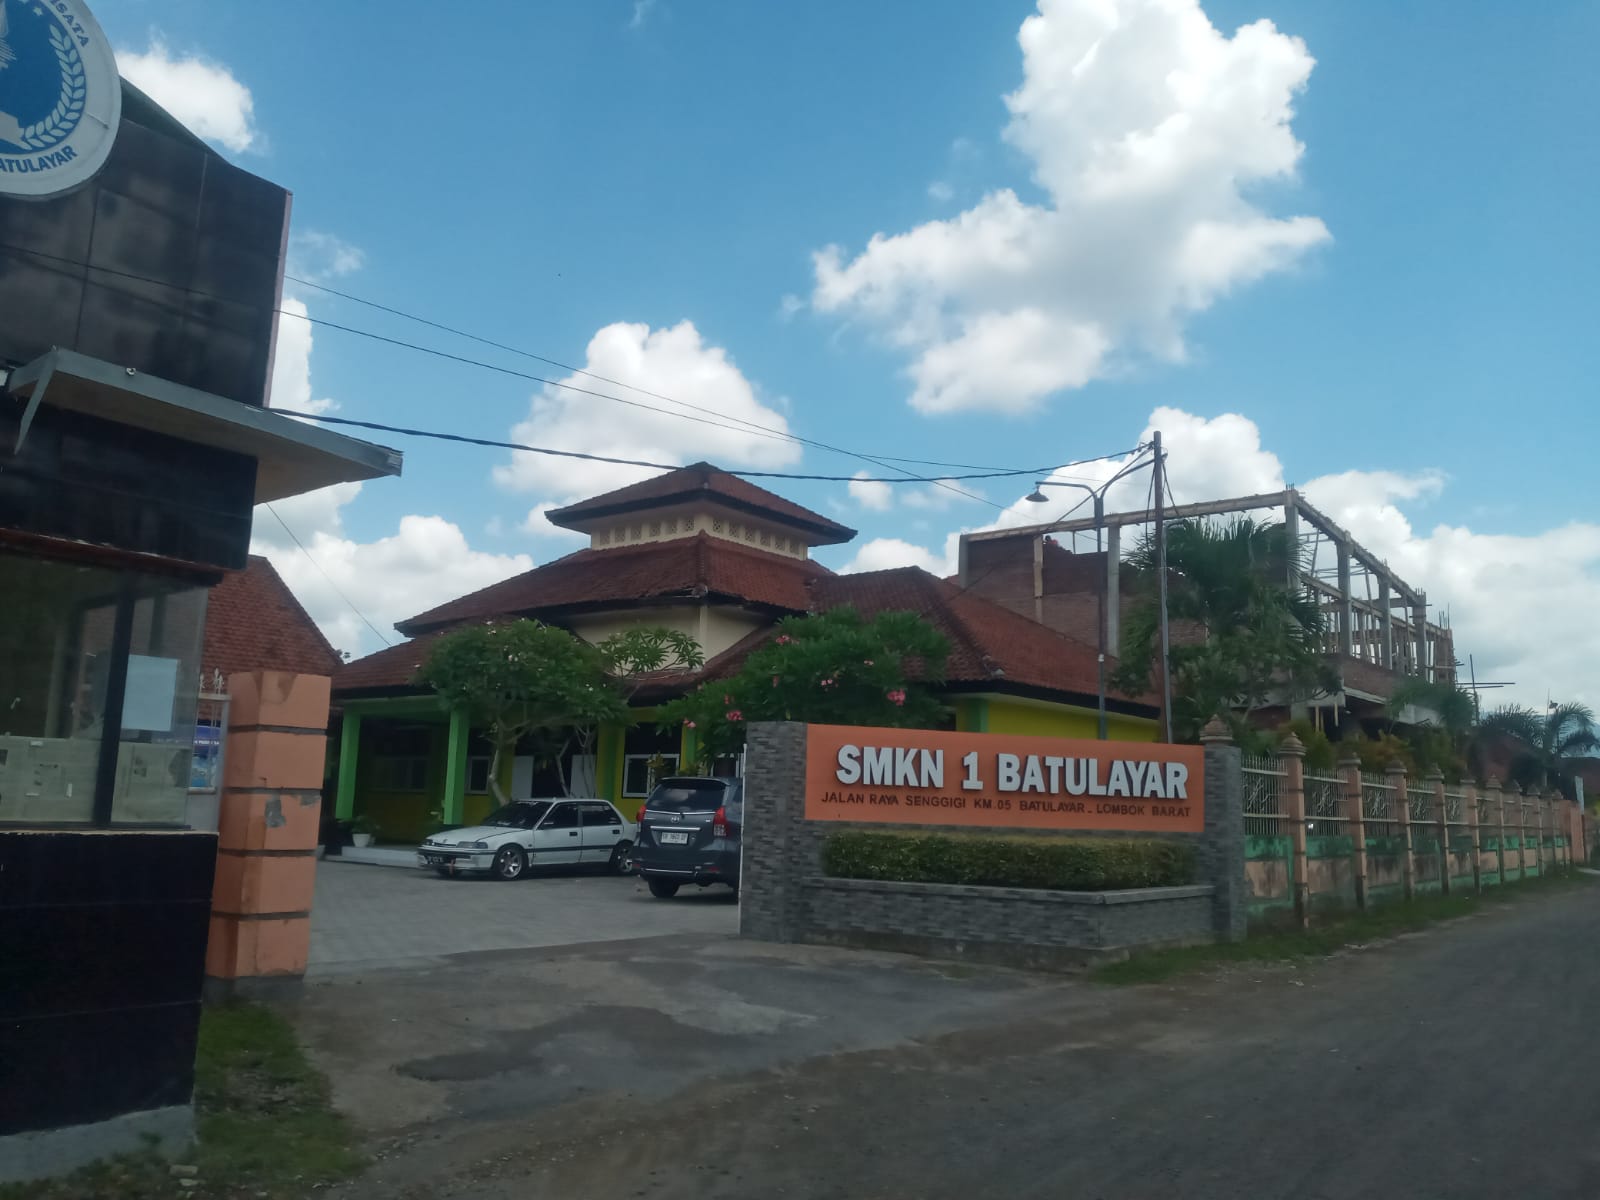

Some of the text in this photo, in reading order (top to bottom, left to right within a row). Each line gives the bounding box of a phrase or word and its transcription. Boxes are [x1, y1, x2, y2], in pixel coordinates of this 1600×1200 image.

[835, 744, 1189, 800] SMKN 1 BATULAYAR
[821, 791, 864, 804] JALAN
[869, 793, 899, 806] RAYA
[905, 795, 966, 809] SENGGIGI
[1019, 800, 1085, 814] BATULAYAR
[1096, 803, 1145, 816] LOMBOK
[1152, 805, 1191, 817] BARAT
